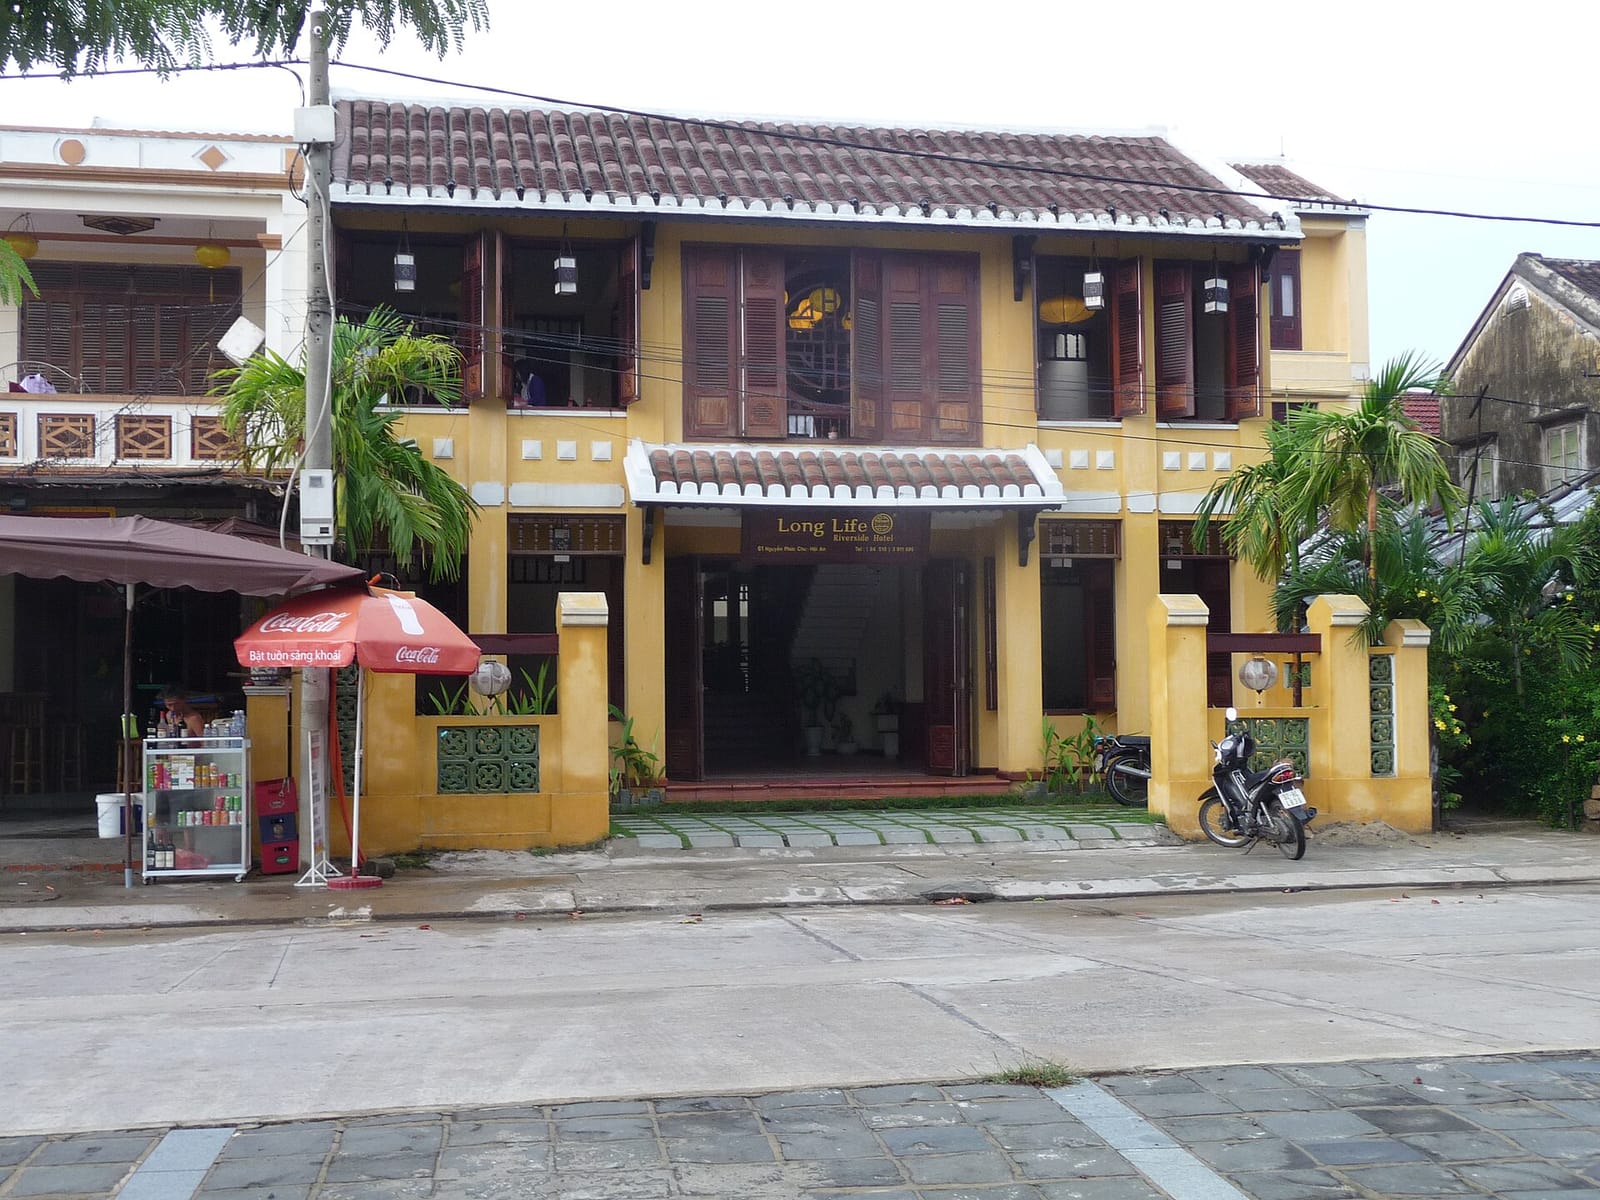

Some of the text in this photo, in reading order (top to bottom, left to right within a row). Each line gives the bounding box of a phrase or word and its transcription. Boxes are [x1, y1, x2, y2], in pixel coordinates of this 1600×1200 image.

[777, 518, 868, 537] Long Life
[833, 534, 894, 542] Riverside Hotel
[249, 650, 265, 663] Bật
[314, 649, 341, 661] khoái
